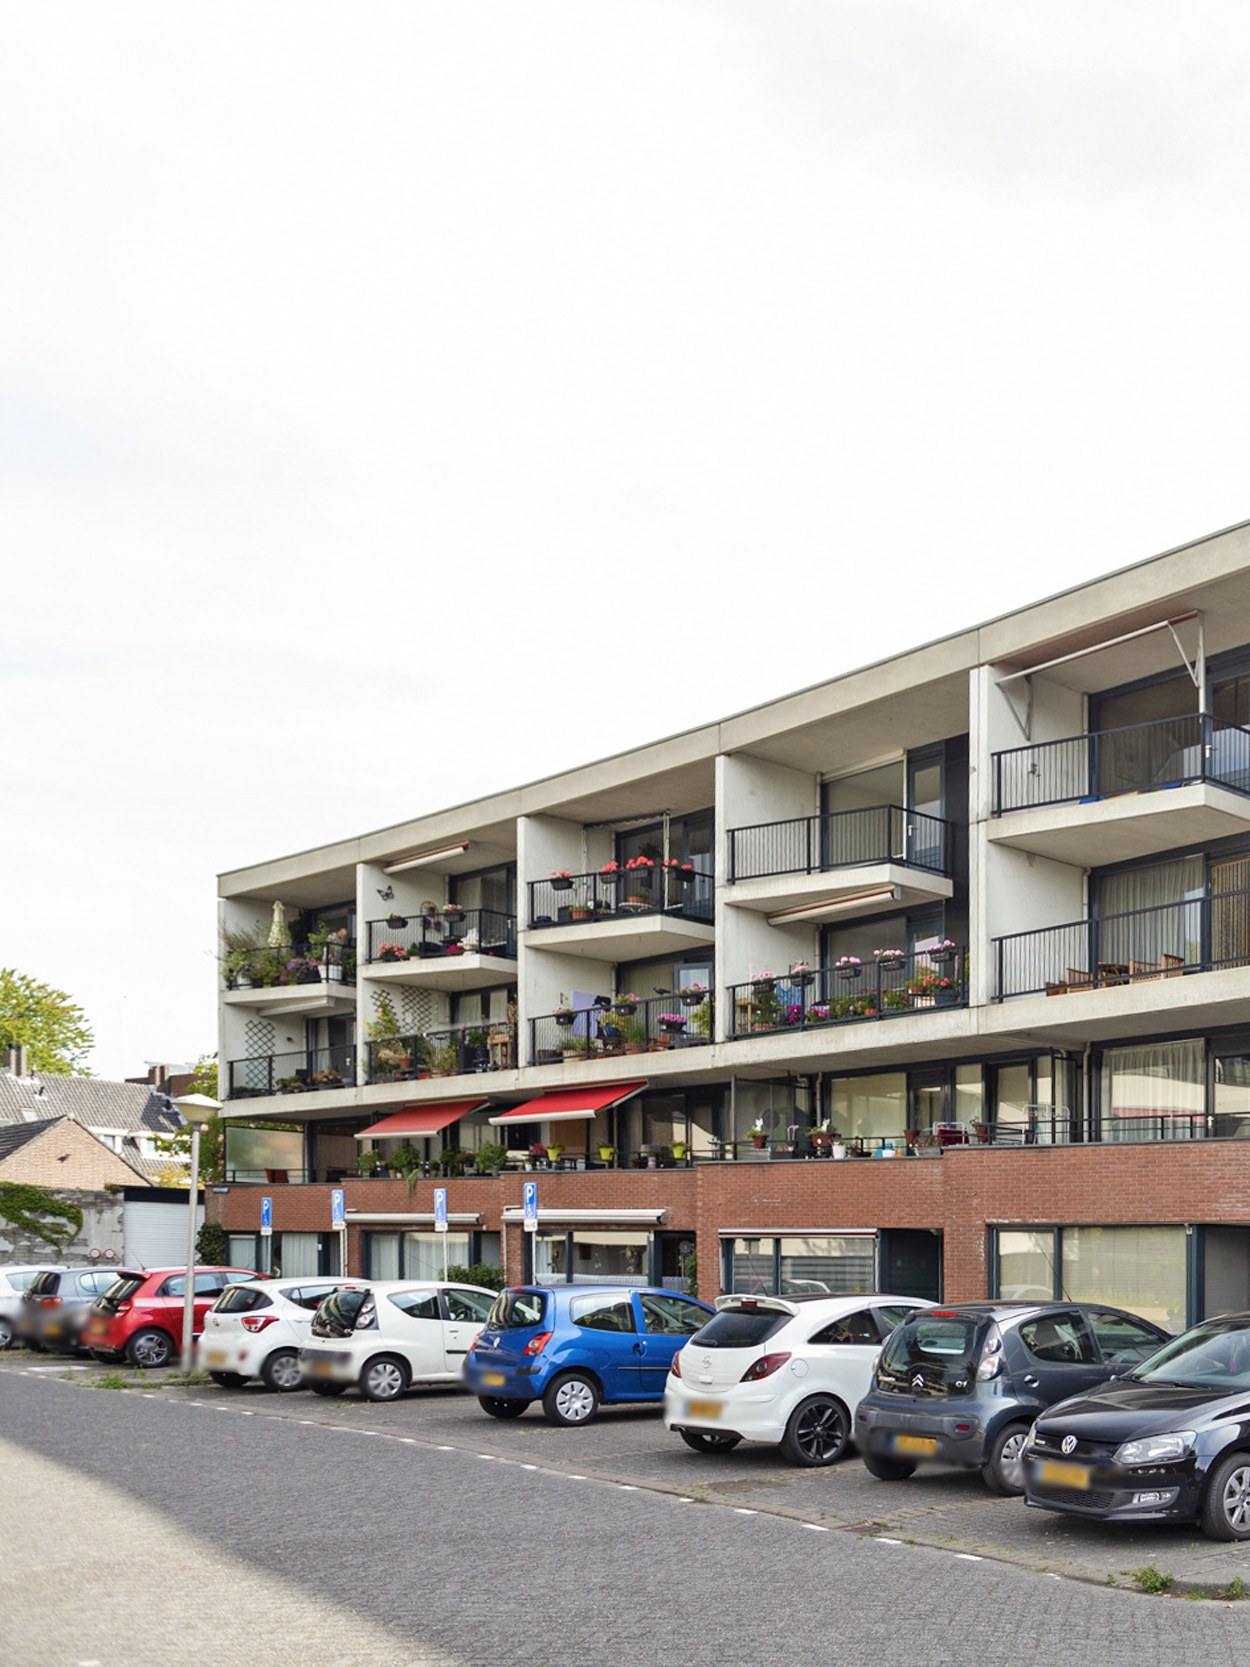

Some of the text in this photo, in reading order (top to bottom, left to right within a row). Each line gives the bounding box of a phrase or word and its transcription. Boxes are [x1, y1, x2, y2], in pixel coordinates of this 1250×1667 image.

[334, 1193, 341, 1208] P
[436, 1192, 443, 1208] P
[526, 1186, 533, 1203] P
[264, 1200, 269, 1215] P
